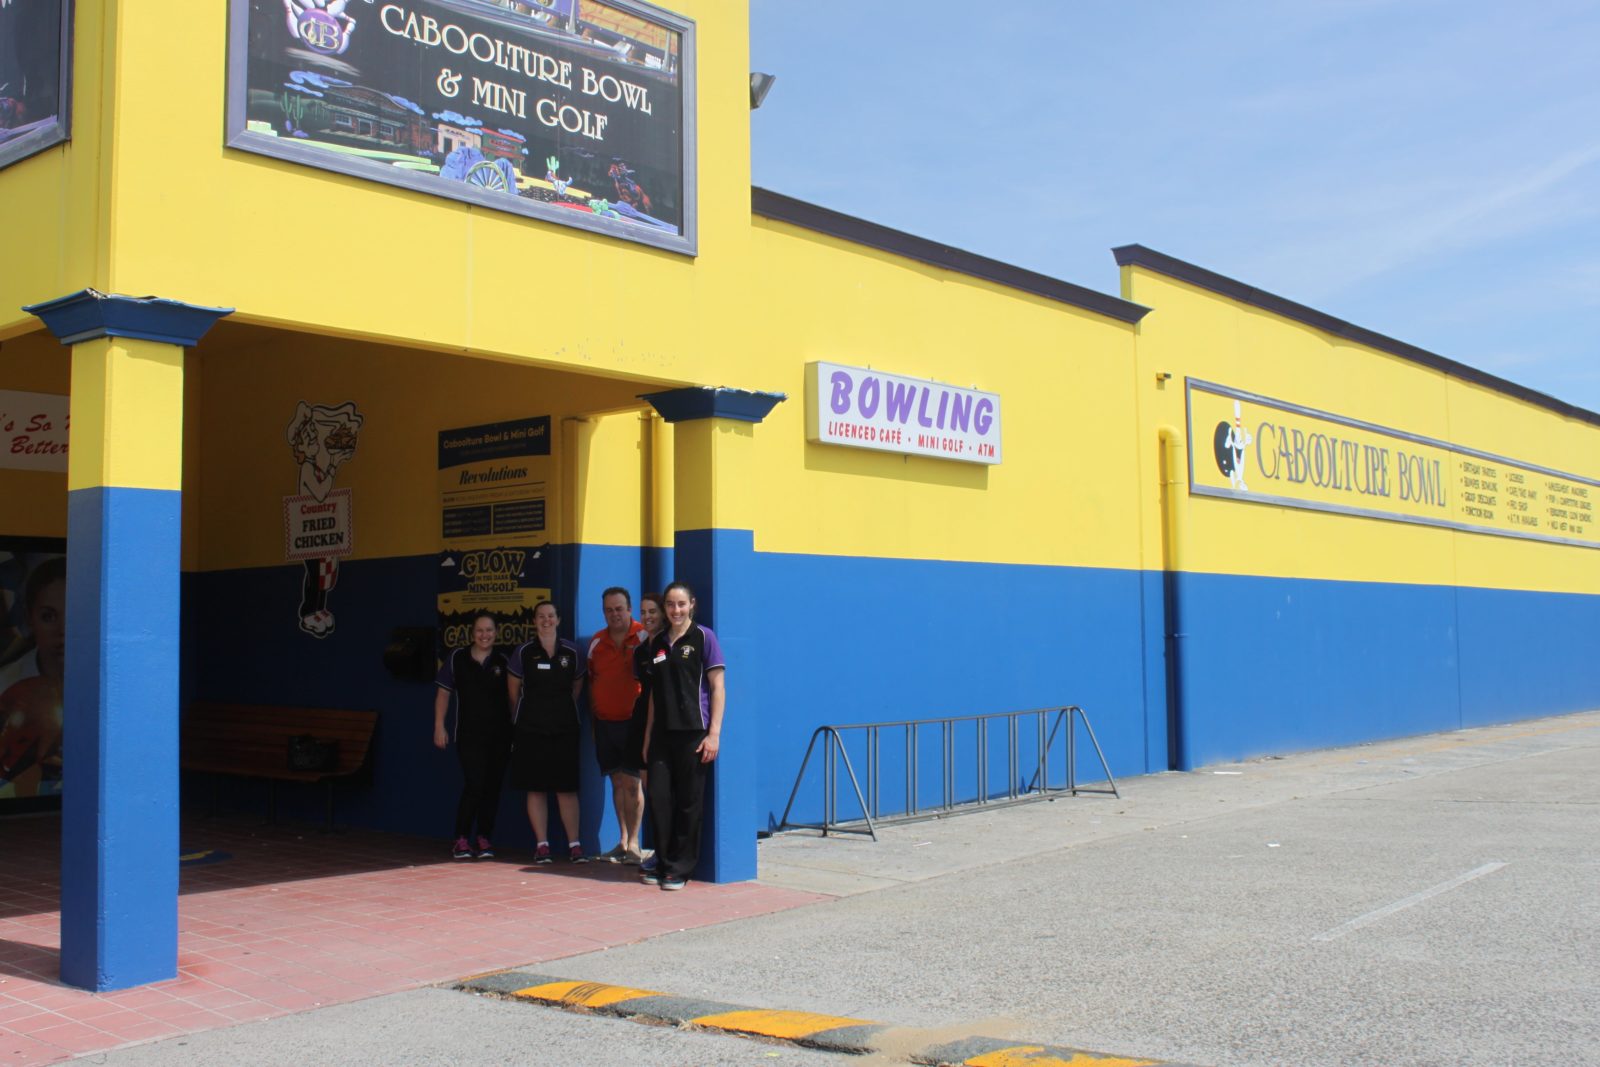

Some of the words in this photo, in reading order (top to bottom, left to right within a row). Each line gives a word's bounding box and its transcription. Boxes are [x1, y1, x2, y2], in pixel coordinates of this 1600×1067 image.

[380, 4, 572, 89] CABOOLTURE
[581, 67, 652, 116] BOWL
[437, 69, 462, 98] &
[471, 76, 526, 119] MINI
[537, 98, 608, 141] GOLF
[830, 371, 994, 436] BOWLING
[25, 414, 52, 432] So
[11, 435, 69, 454] Better
[443, 437, 483, 449] Caboolture
[484, 432, 502, 444] Bowl
[510, 428, 527, 439] Mini
[527, 424, 545, 437] Golf
[828, 421, 876, 441] LICENCED
[879, 428, 902, 445] CAFÉ
[918, 434, 939, 450] MINI
[942, 438, 964, 453] GOLF
[977, 443, 995, 457] ATM
[459, 465, 528, 486] Revolutions
[1256, 422, 1391, 498] CABOOLTURE
[1397, 451, 1446, 507] BOWL
[300, 502, 336, 515] Country
[302, 517, 336, 532] FRIED
[294, 532, 344, 549] CHICKEN
[462, 550, 526, 578] GLOW
